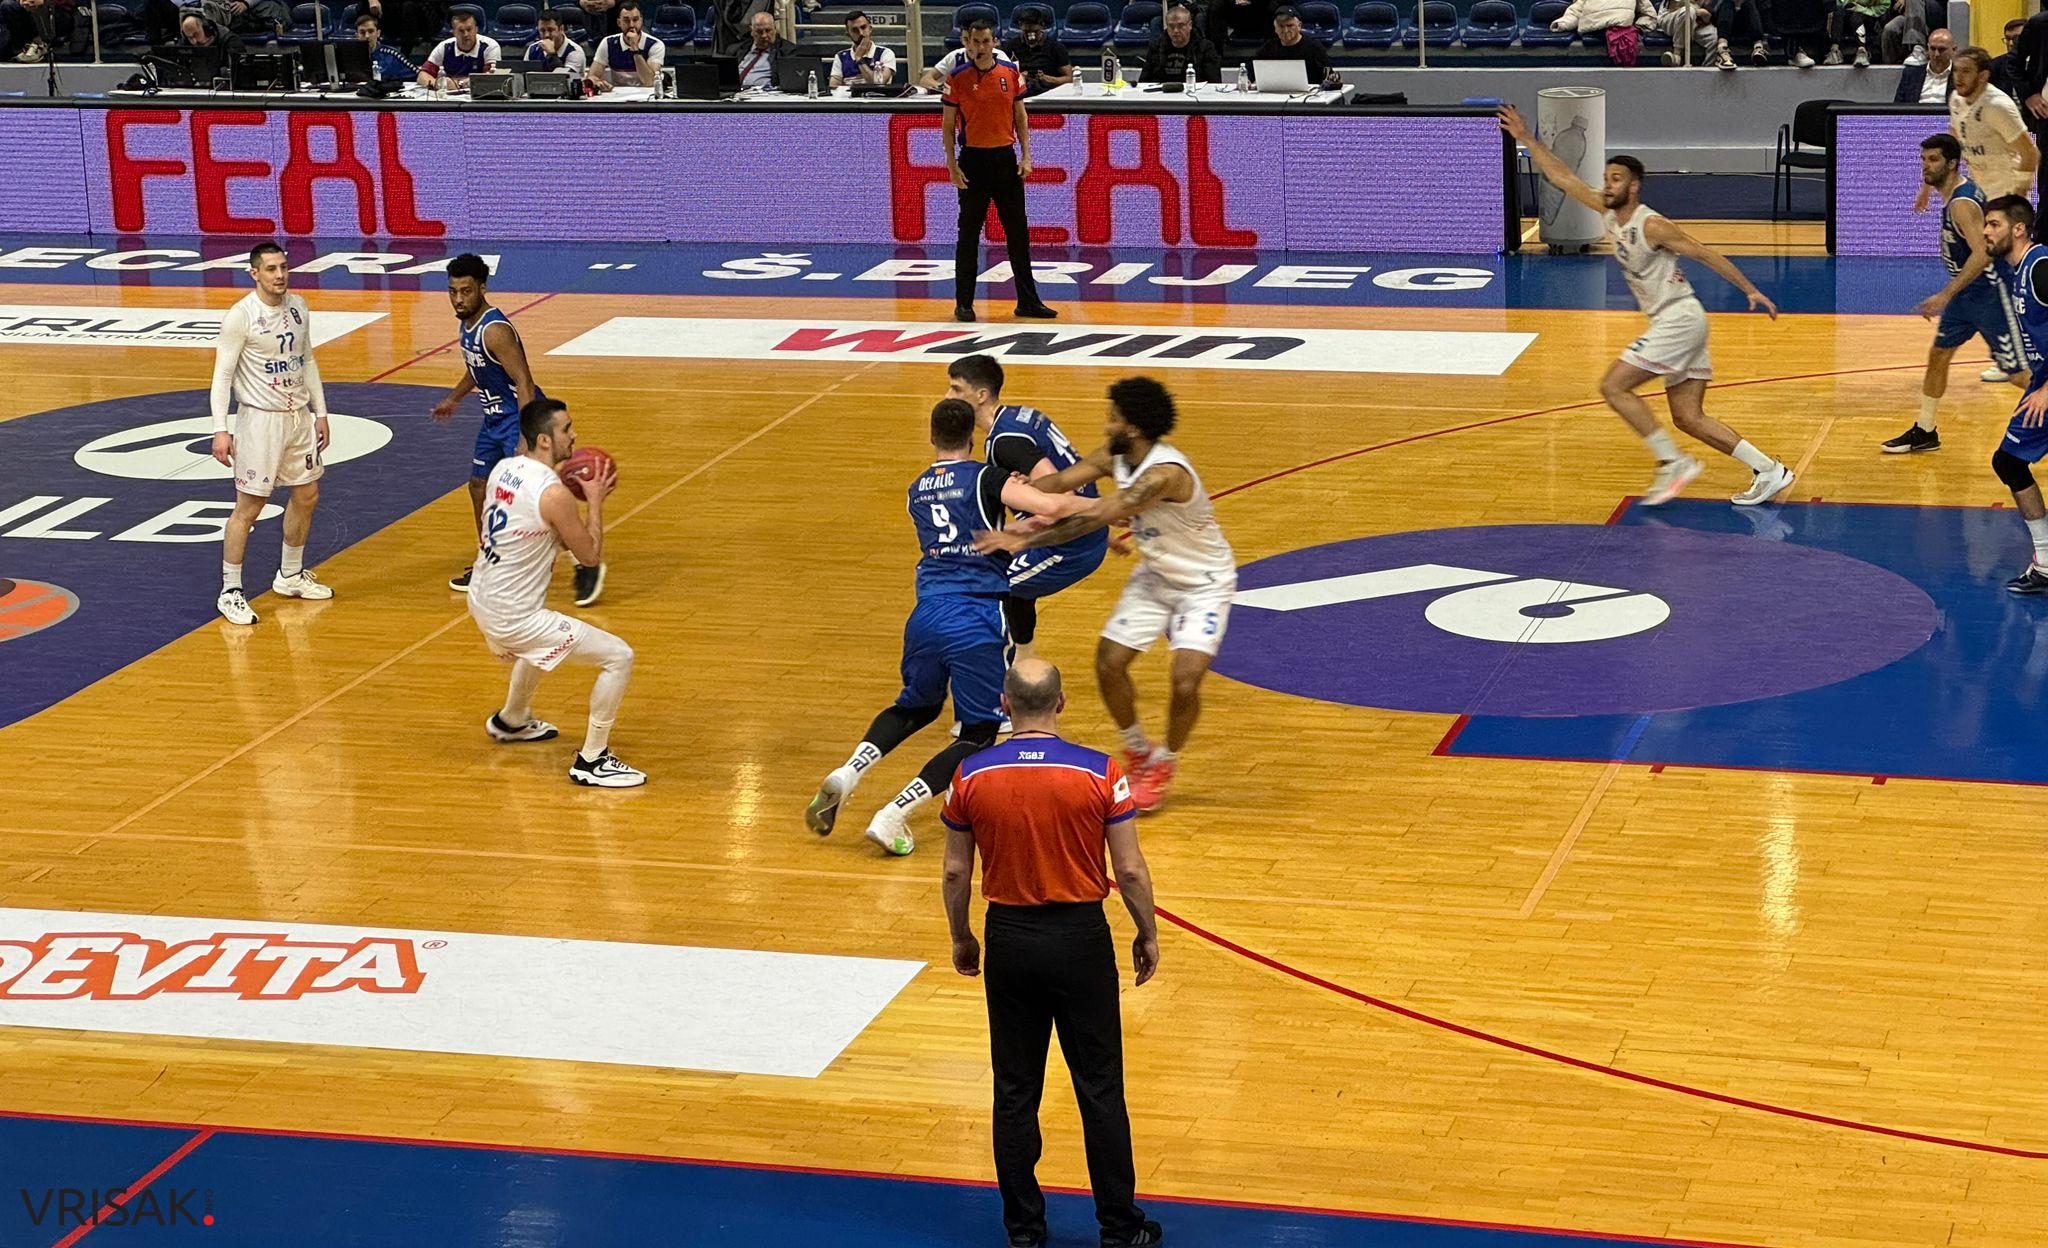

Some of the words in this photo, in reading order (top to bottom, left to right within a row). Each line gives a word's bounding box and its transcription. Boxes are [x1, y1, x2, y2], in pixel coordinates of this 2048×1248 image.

[106, 109, 446, 237] FEAL
[0, 247, 500, 276] ECARA
[276, 332, 295, 354] 77
[930, 504, 958, 542] 9
